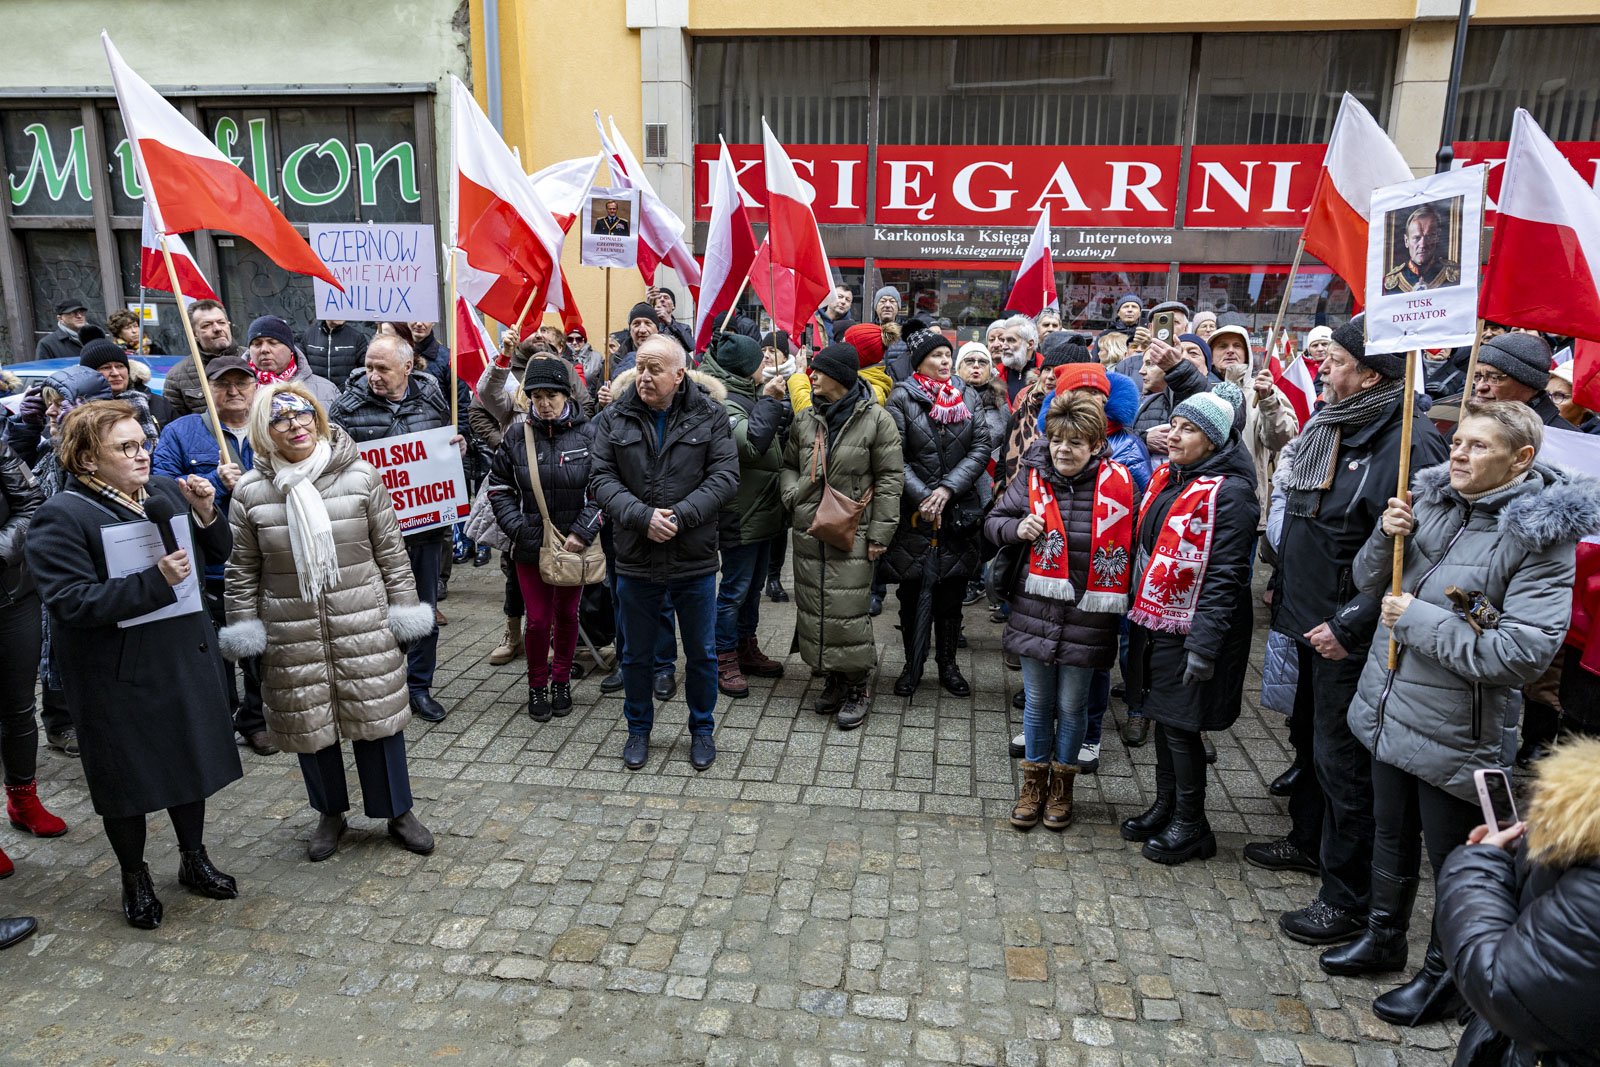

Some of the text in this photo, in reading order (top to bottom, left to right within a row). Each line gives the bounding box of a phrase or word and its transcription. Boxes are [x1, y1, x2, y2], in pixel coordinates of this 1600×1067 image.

[317, 229, 418, 262] CZERNOW
[874, 228, 965, 242] Karkonoska
[1078, 231, 1173, 245] Internetowa
[329, 264, 422, 283] AMIĘTAMY
[325, 285, 412, 313] ANILUX
[1406, 298, 1433, 309] TUSK
[1392, 309, 1446, 322] DYKTATOR
[381, 469, 410, 489] dla
